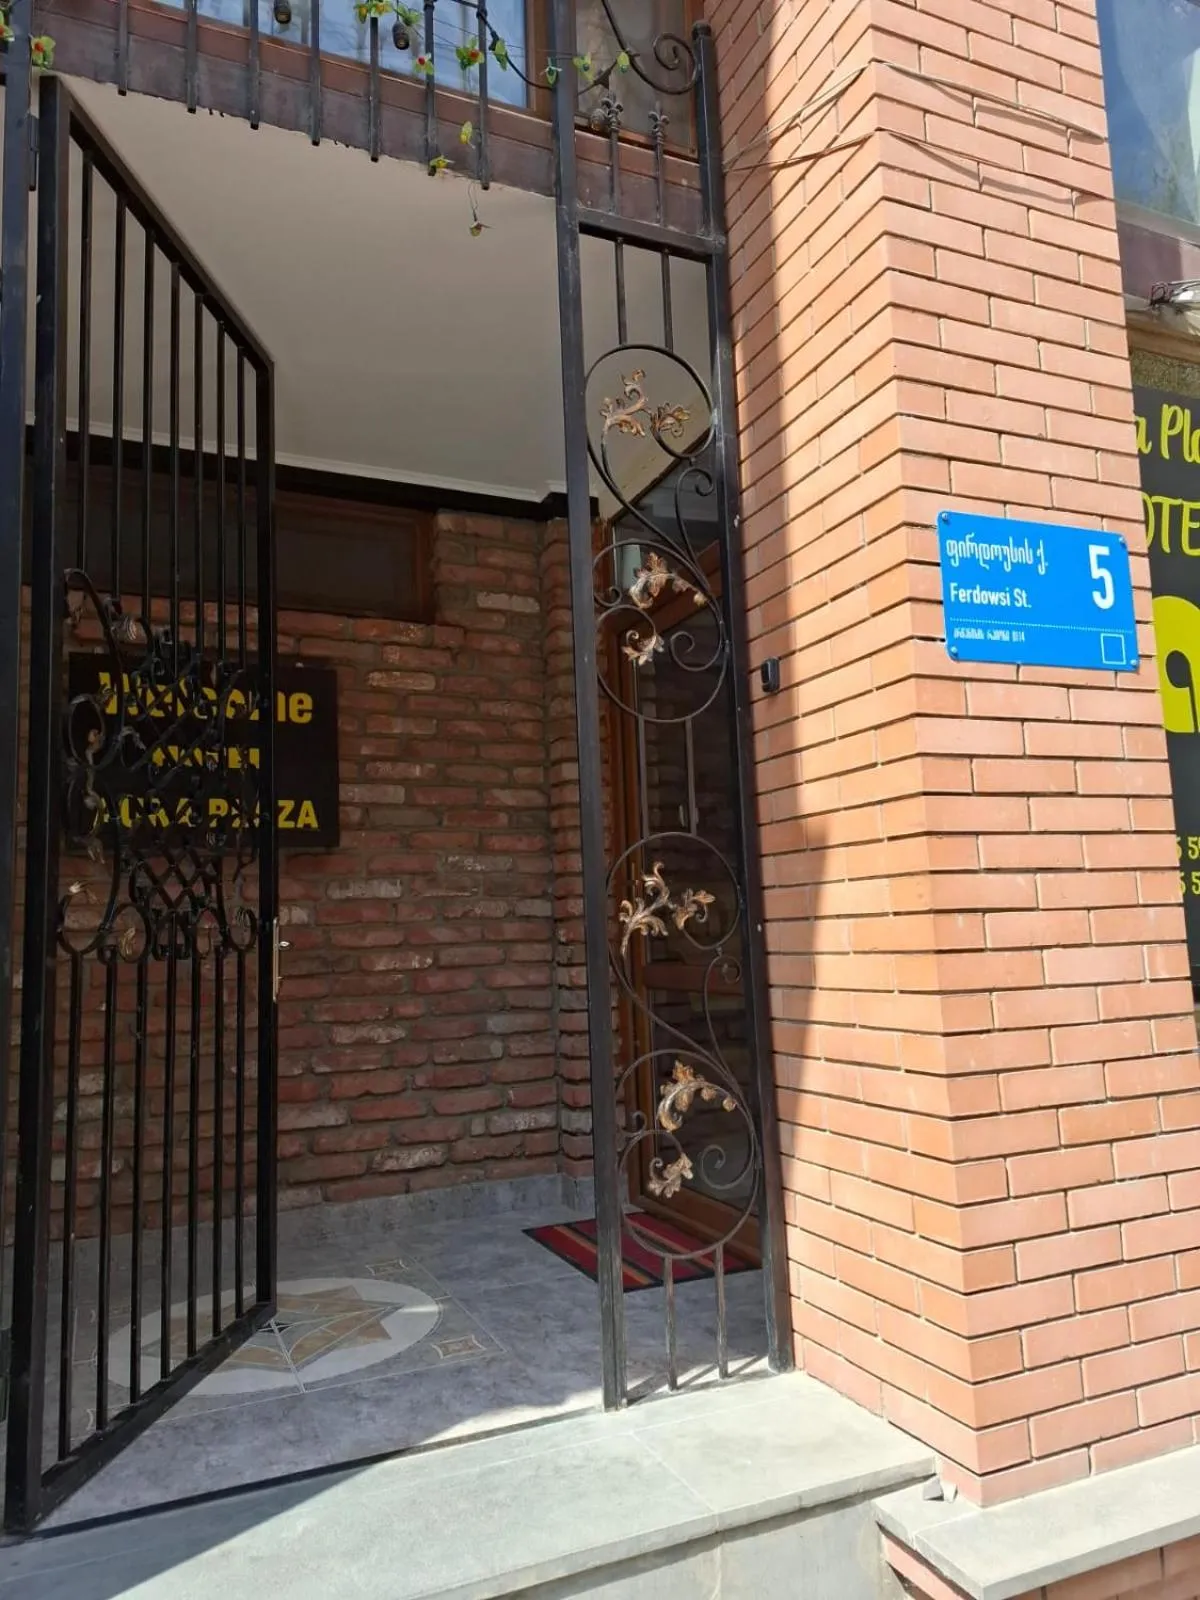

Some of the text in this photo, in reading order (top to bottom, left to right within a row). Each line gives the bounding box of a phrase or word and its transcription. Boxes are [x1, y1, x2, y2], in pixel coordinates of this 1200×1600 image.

[946, 531, 1034, 572] ფირდოუსის
[949, 582, 1033, 609] Ferdowsi St.
[1088, 544, 1115, 610] 5
[97, 795, 198, 829] URA
